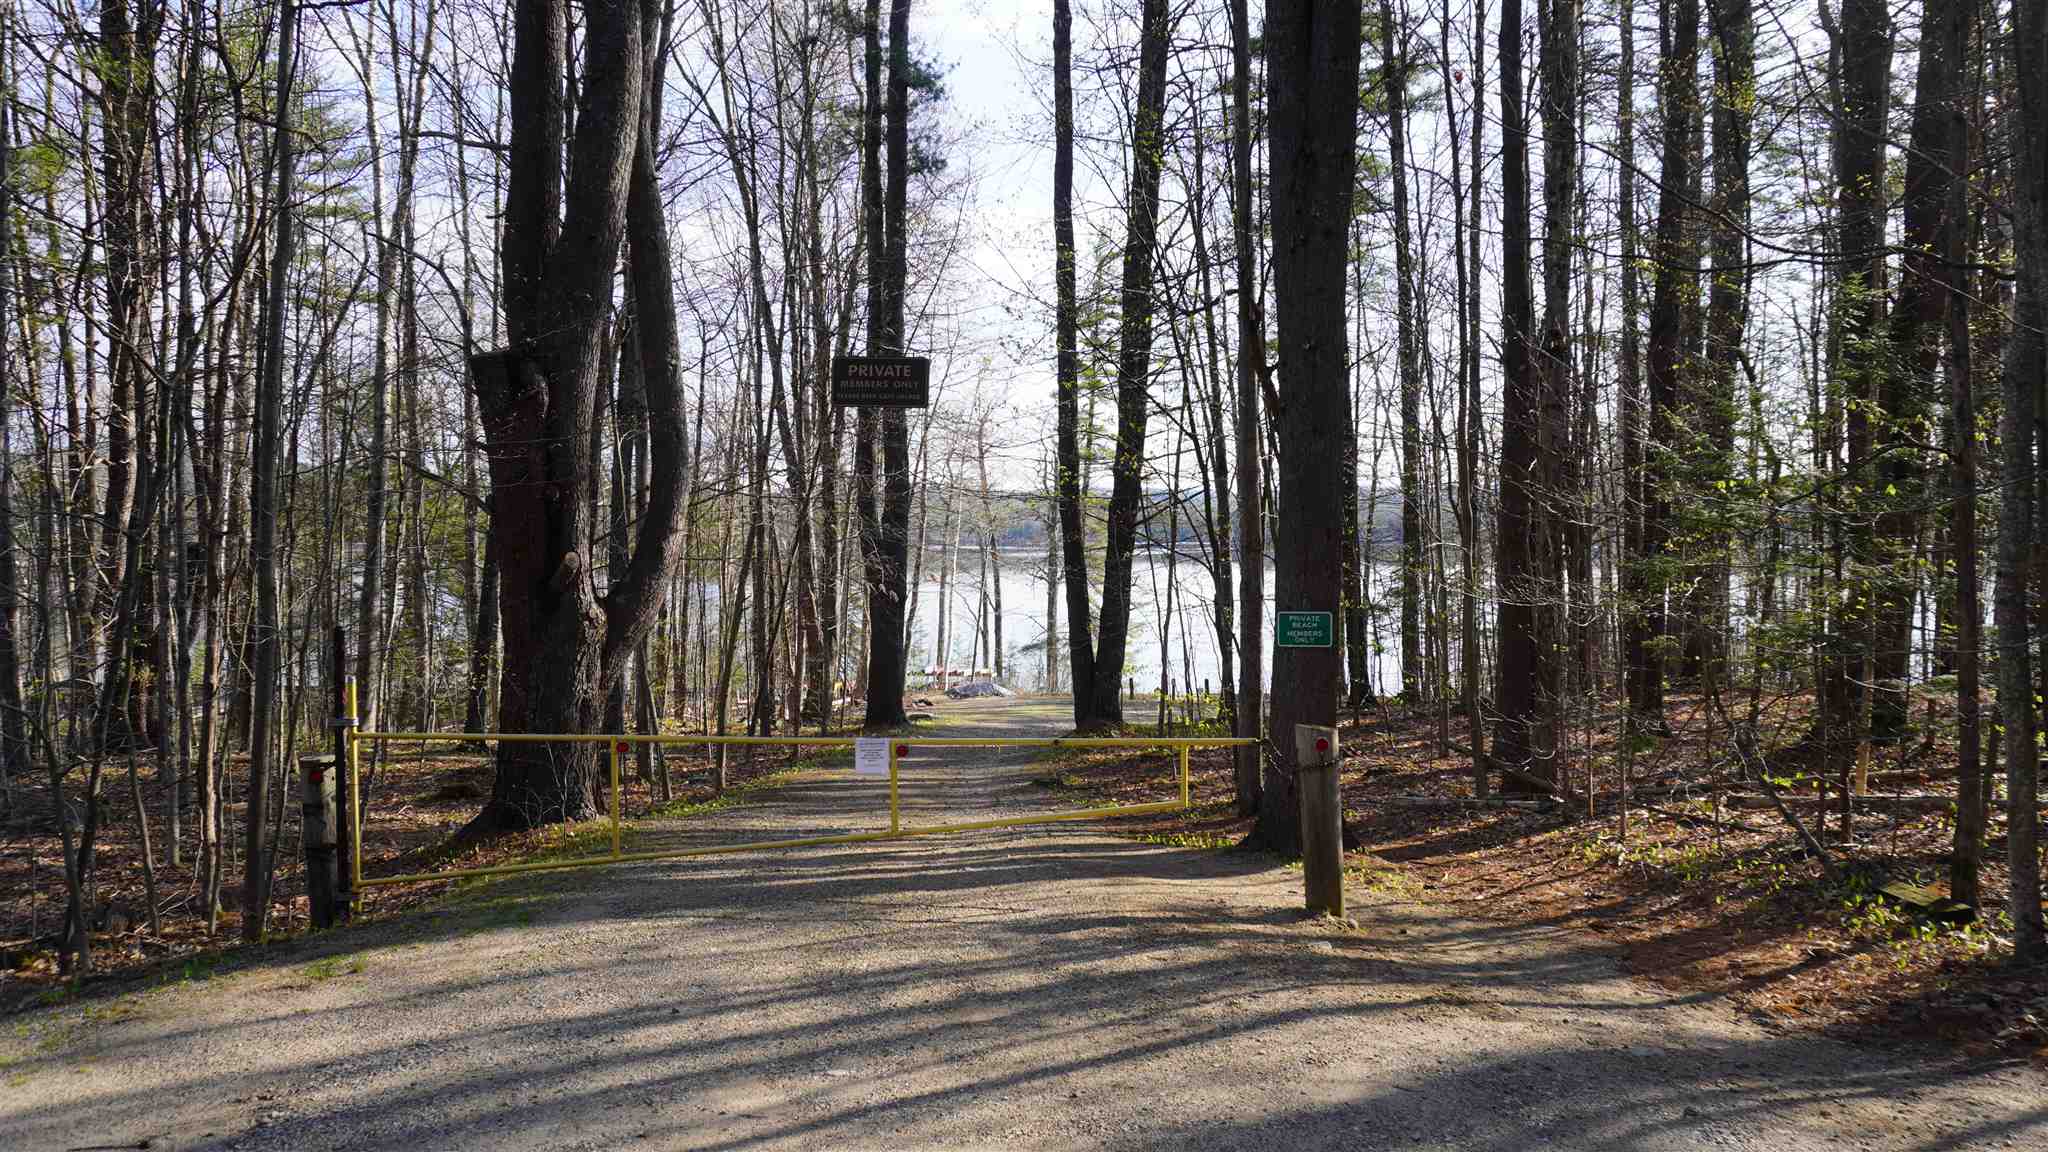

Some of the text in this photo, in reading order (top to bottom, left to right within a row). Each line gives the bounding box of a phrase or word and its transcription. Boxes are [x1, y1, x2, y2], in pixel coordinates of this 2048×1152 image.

[847, 364, 912, 377] PRIVATE
[839, 379, 920, 389] MEMBERS ONLY
